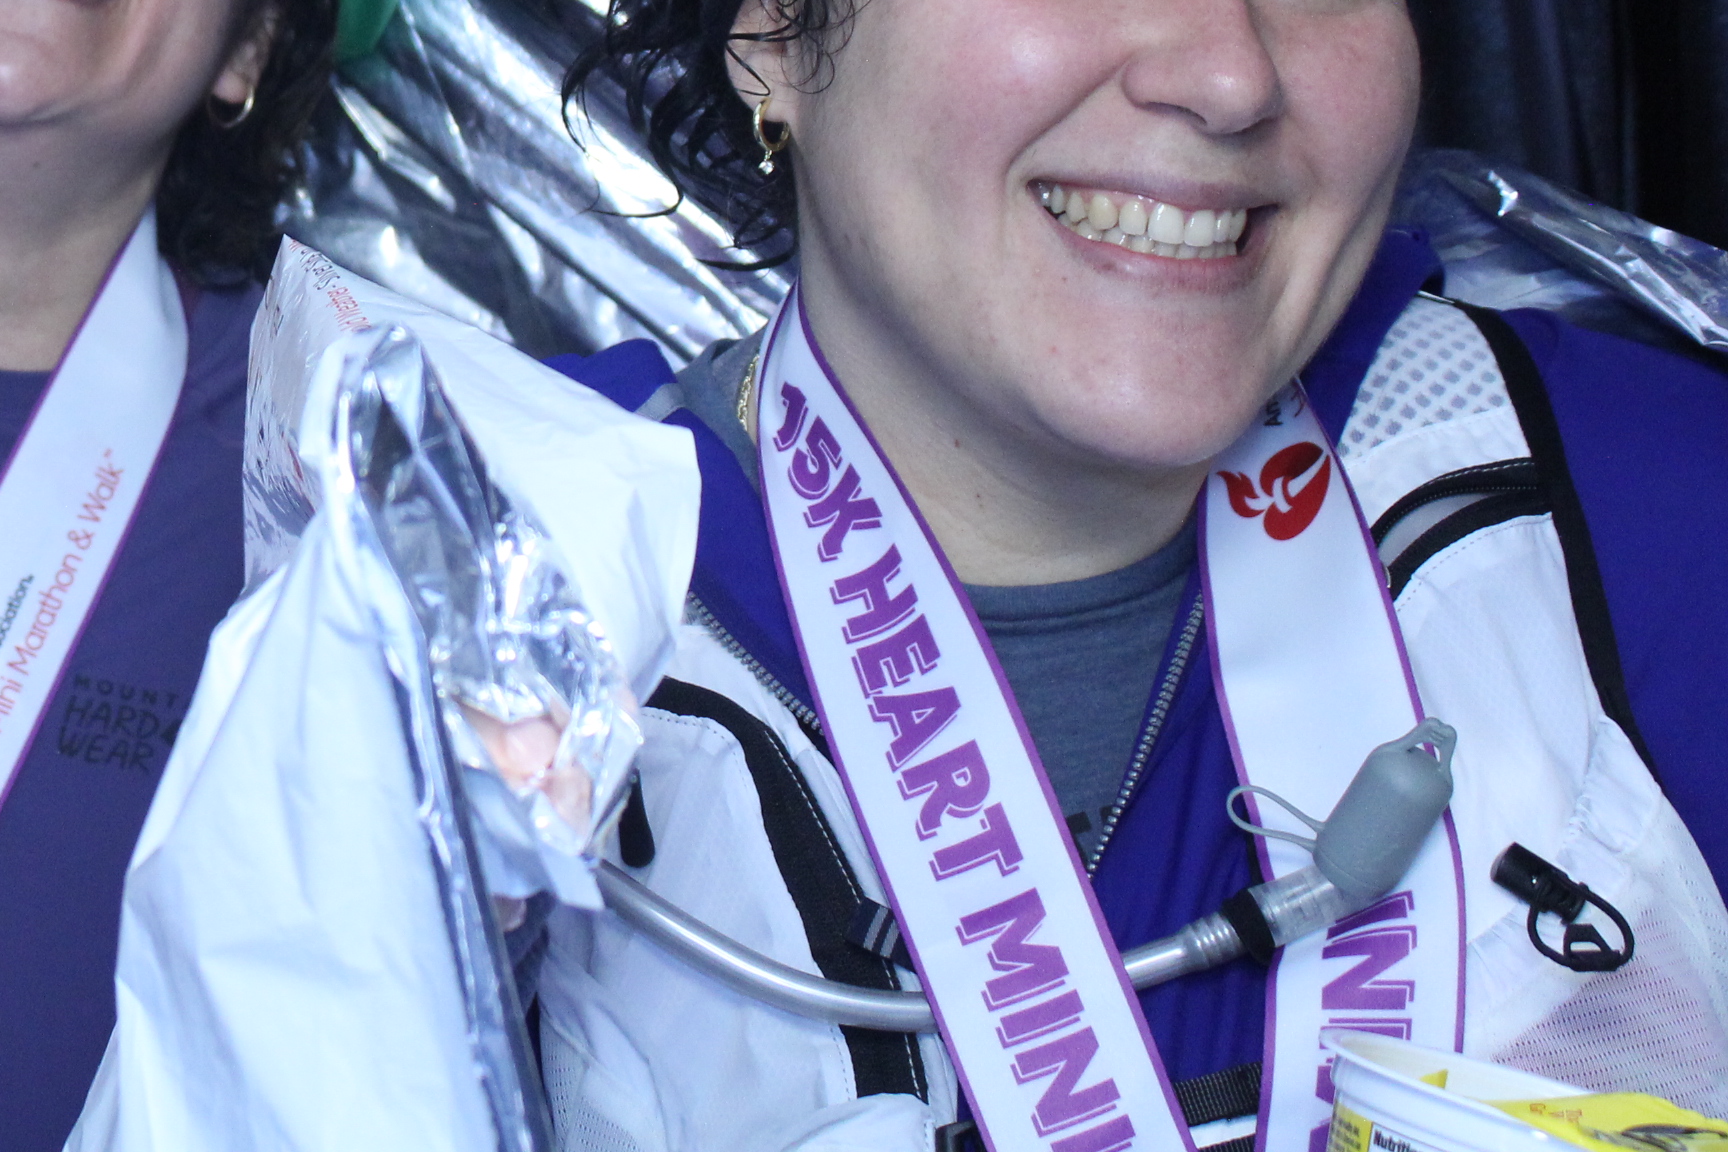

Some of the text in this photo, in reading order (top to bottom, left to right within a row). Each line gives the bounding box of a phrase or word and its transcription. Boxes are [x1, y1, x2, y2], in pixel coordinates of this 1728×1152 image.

[7, 553, 83, 677] Marathon
[67, 528, 95, 551] &
[58, 725, 154, 776] WEAR
[64, 694, 160, 739] HARD
[772, 381, 1137, 1152] 15K HEART MINI
